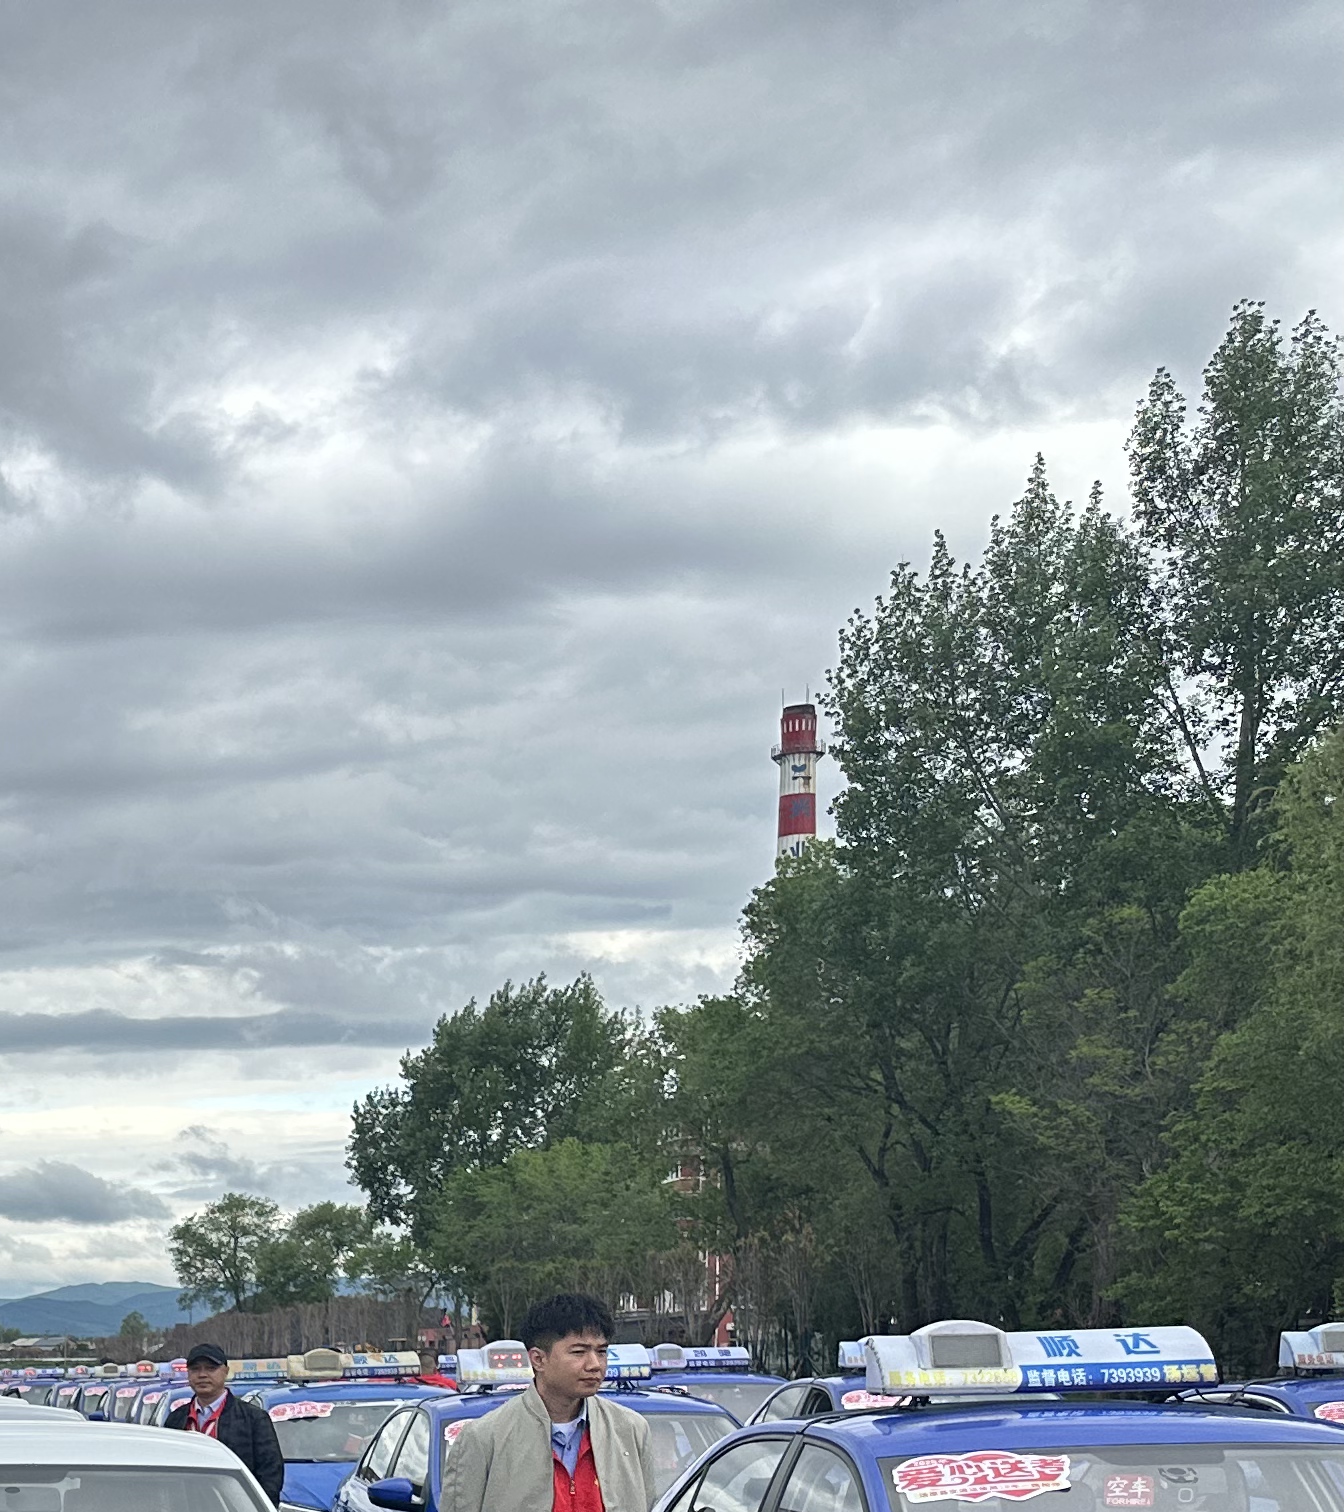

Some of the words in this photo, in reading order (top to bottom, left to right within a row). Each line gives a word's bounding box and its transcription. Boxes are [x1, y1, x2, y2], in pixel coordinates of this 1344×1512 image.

[898, 1458, 1069, 1491] 爱心送考
[1106, 1475, 1151, 1498] 空车
